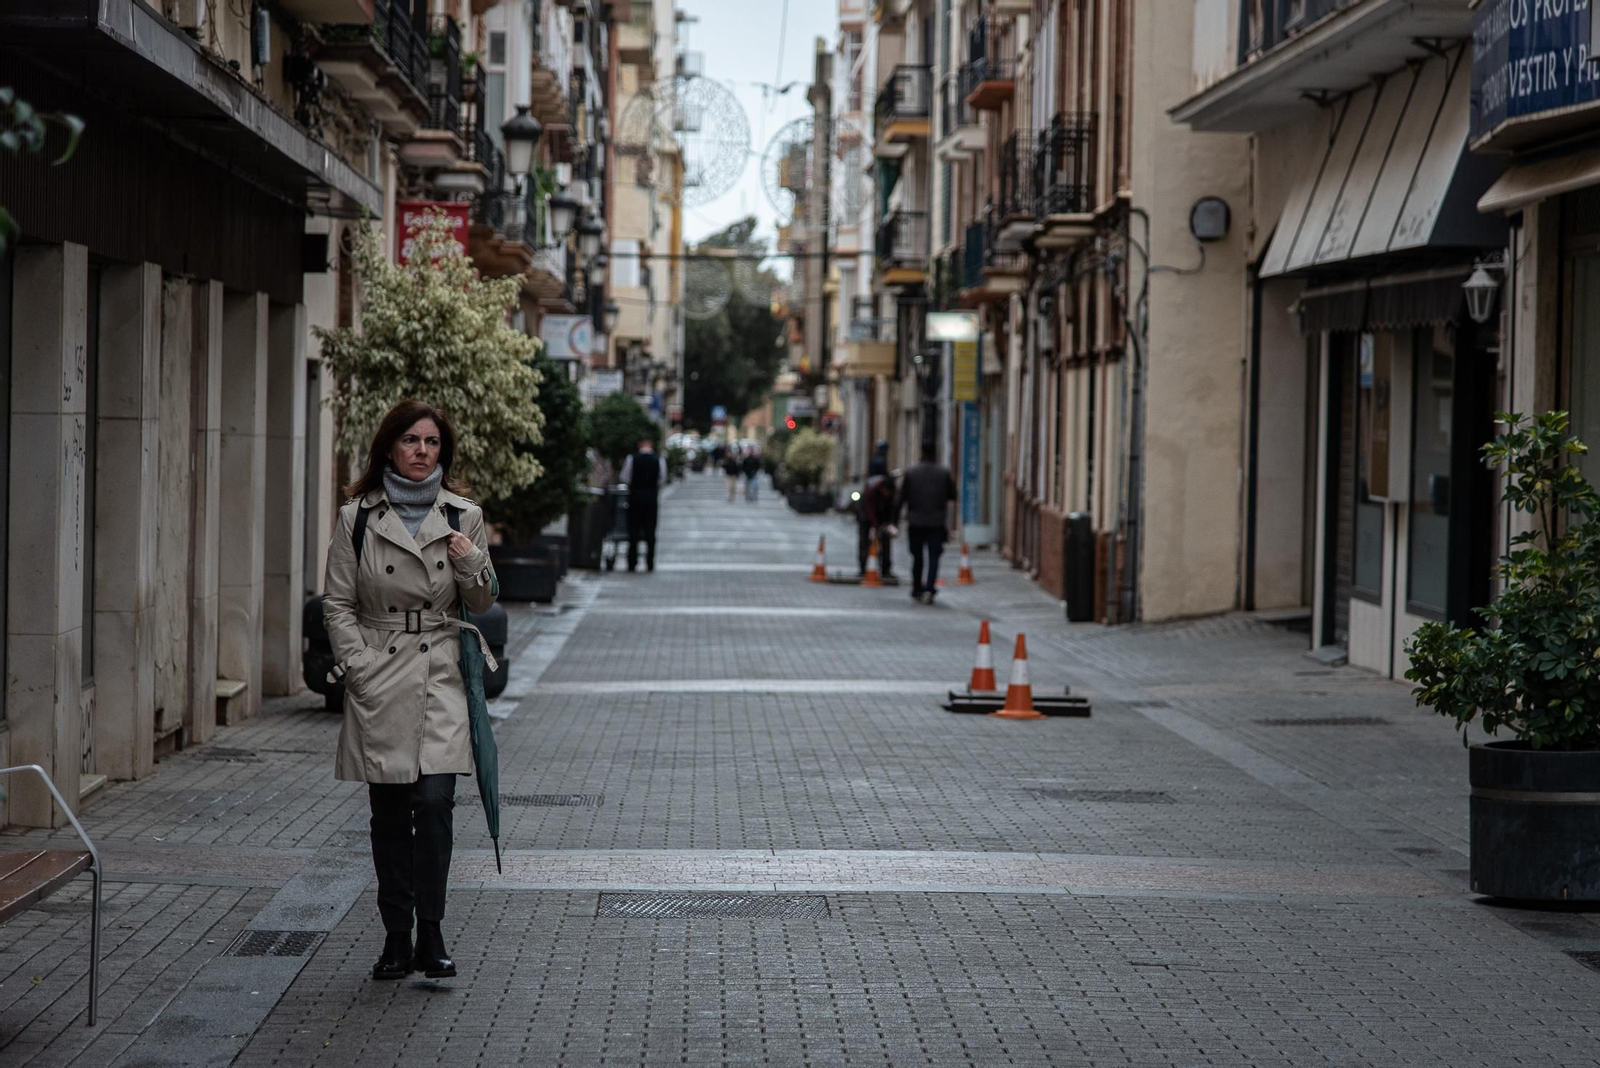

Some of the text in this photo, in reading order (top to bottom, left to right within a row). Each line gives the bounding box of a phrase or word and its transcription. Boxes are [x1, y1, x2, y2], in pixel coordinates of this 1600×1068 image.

[1534, 0, 1588, 22] PRO
[1508, 50, 1557, 98] VESTIR
[1563, 46, 1573, 86] Y
